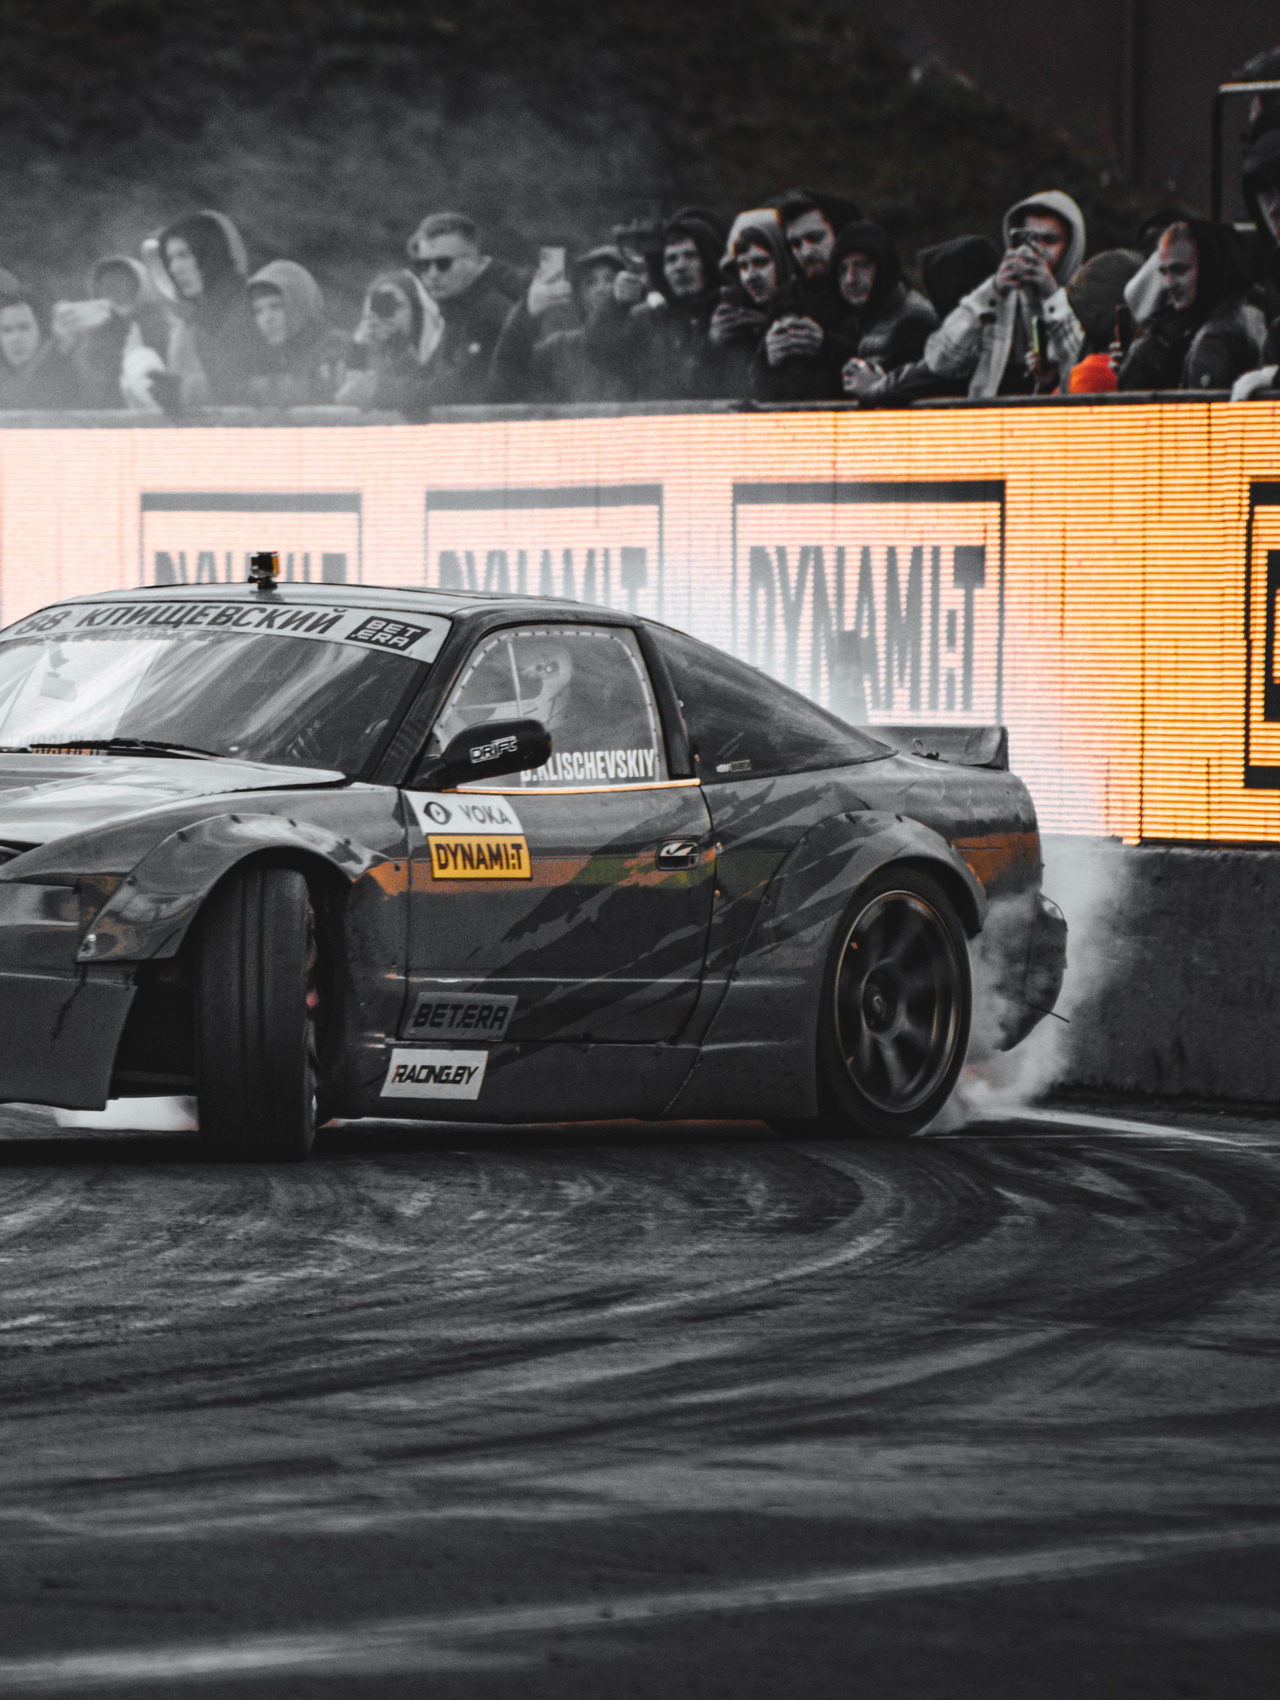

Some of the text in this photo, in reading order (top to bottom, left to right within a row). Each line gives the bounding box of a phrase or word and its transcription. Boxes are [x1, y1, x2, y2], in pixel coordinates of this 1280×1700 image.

[15, 605, 348, 635] 88 КЛИЩЕВСКИЙ
[365, 619, 422, 637] BET
[458, 804, 513, 825] VOKA
